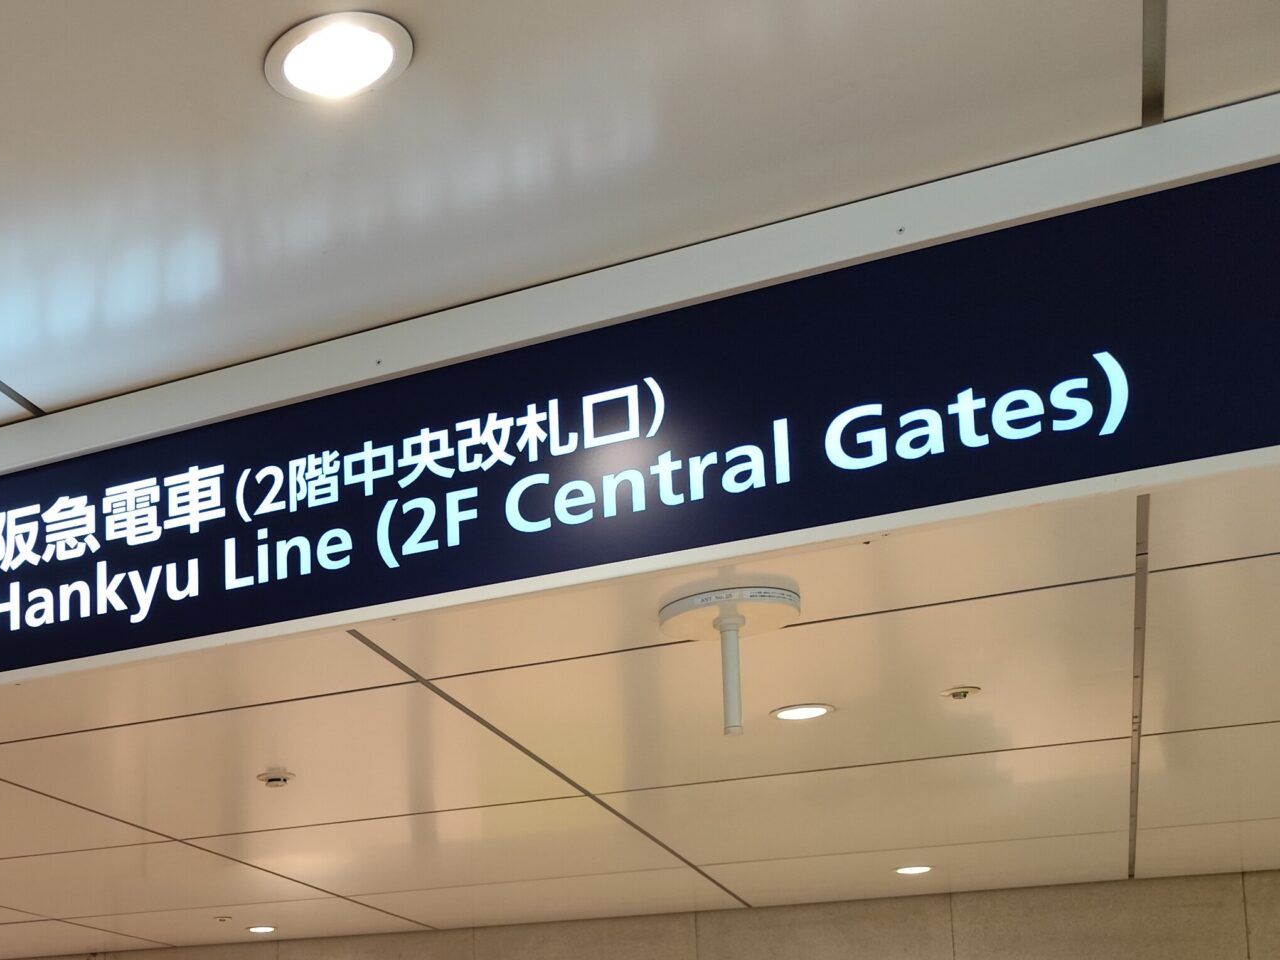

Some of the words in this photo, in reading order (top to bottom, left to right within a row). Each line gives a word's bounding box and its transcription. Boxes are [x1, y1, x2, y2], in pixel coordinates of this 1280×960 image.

[224, 526, 353, 591] Line
[376, 486, 478, 569] (2F
[505, 417, 791, 534] Central
[824, 351, 1129, 470] Gates)
